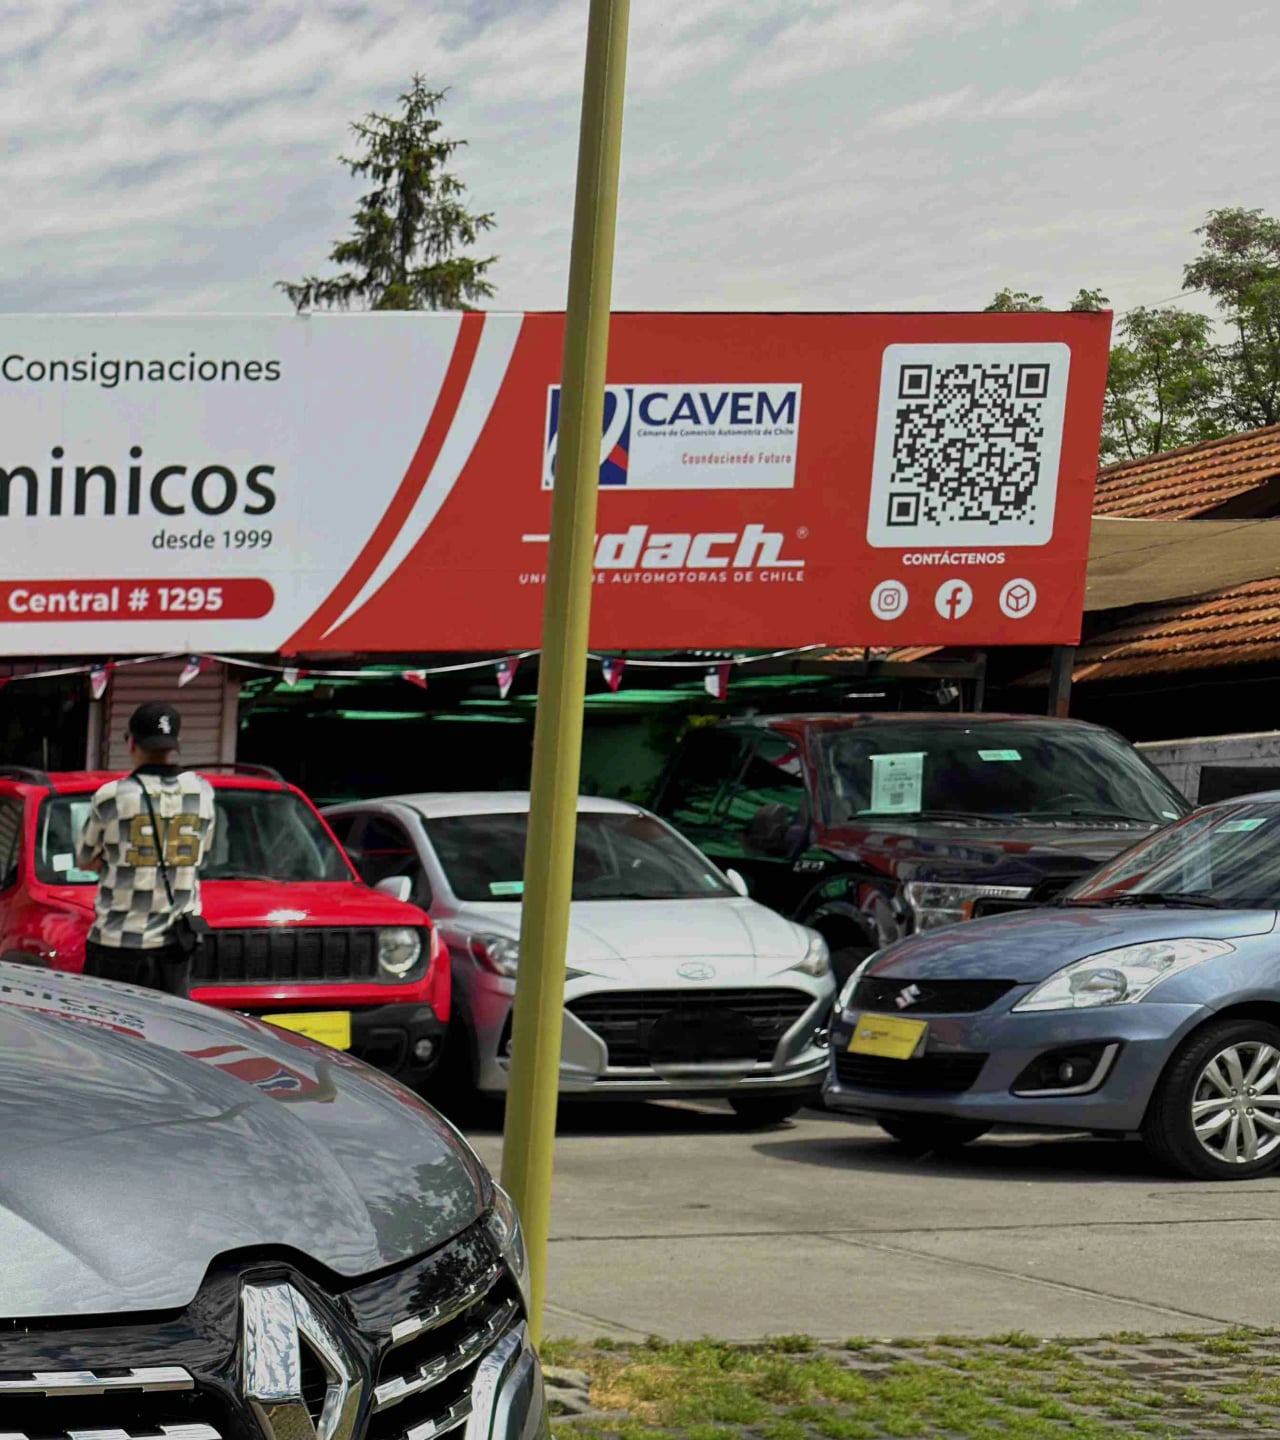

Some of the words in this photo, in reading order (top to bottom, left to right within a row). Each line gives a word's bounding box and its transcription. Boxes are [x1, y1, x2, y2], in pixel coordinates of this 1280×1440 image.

[1, 352, 281, 389] Consignaciones
[638, 391, 797, 427] CAVEM
[669, 428, 678, 437] de
[679, 428, 716, 437] Comercio
[718, 428, 761, 437] Automotriz
[762, 428, 772, 436] de
[774, 428, 795, 436] Chile
[758, 451, 792, 464] Futuro
[151, 529, 216, 549] desde
[223, 529, 273, 549] 1999
[522, 523, 805, 569] dach
[902, 551, 1006, 566] CONTÁCTENOS
[519, 573, 545, 584] UNI
[611, 572, 727, 584] AUTOMOTORAS
[733, 571, 753, 583] DE
[759, 570, 804, 582] CHILE
[8, 587, 119, 613] Central
[127, 587, 150, 611] #
[157, 587, 223, 611] 1295
